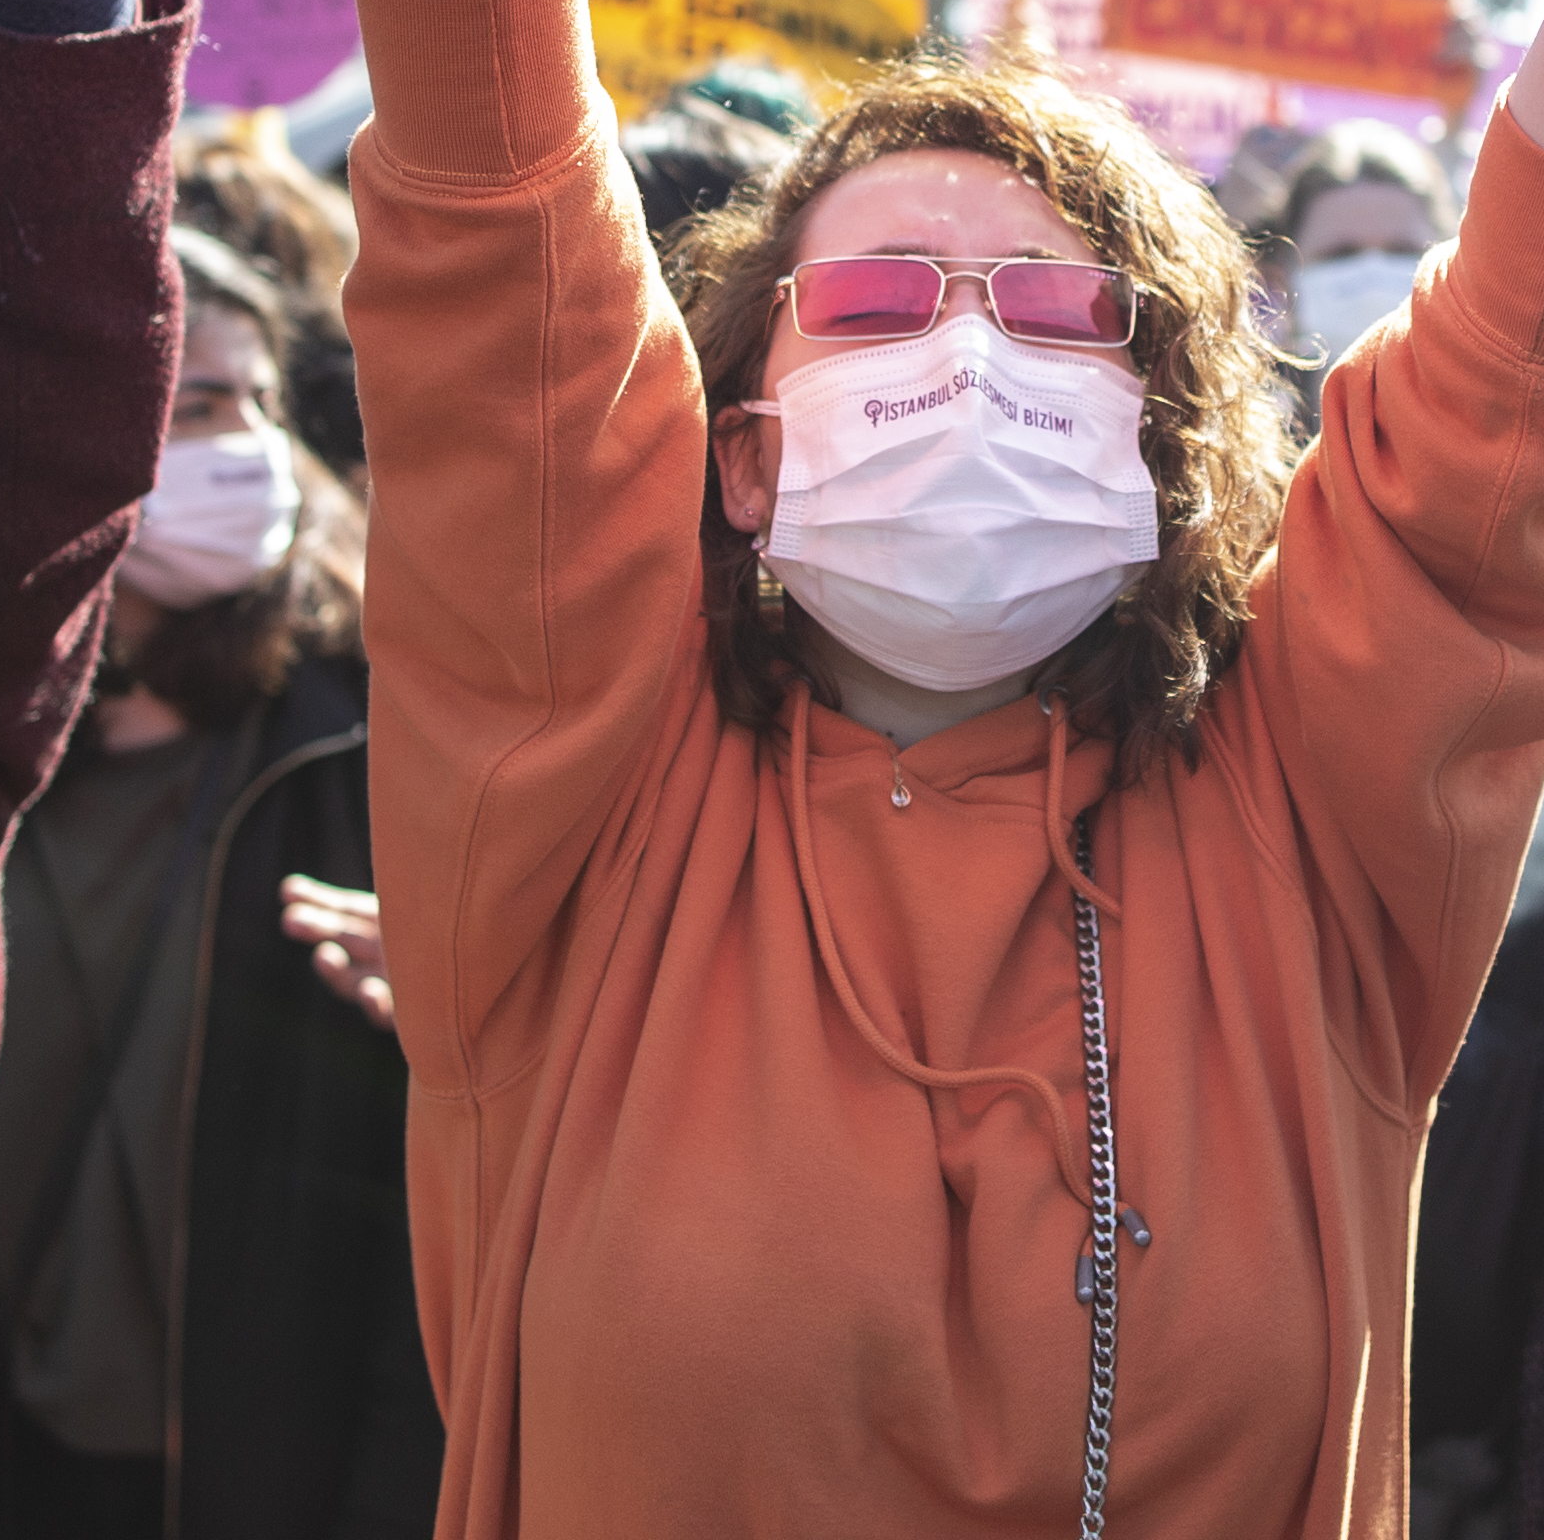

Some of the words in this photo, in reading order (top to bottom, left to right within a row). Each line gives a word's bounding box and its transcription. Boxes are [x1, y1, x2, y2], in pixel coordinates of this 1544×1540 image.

[884, 383, 953, 422] İSTANBUL
[952, 367, 1018, 423] SÖZLEŞMESİ
[1023, 407, 1074, 438] BİZİM!
